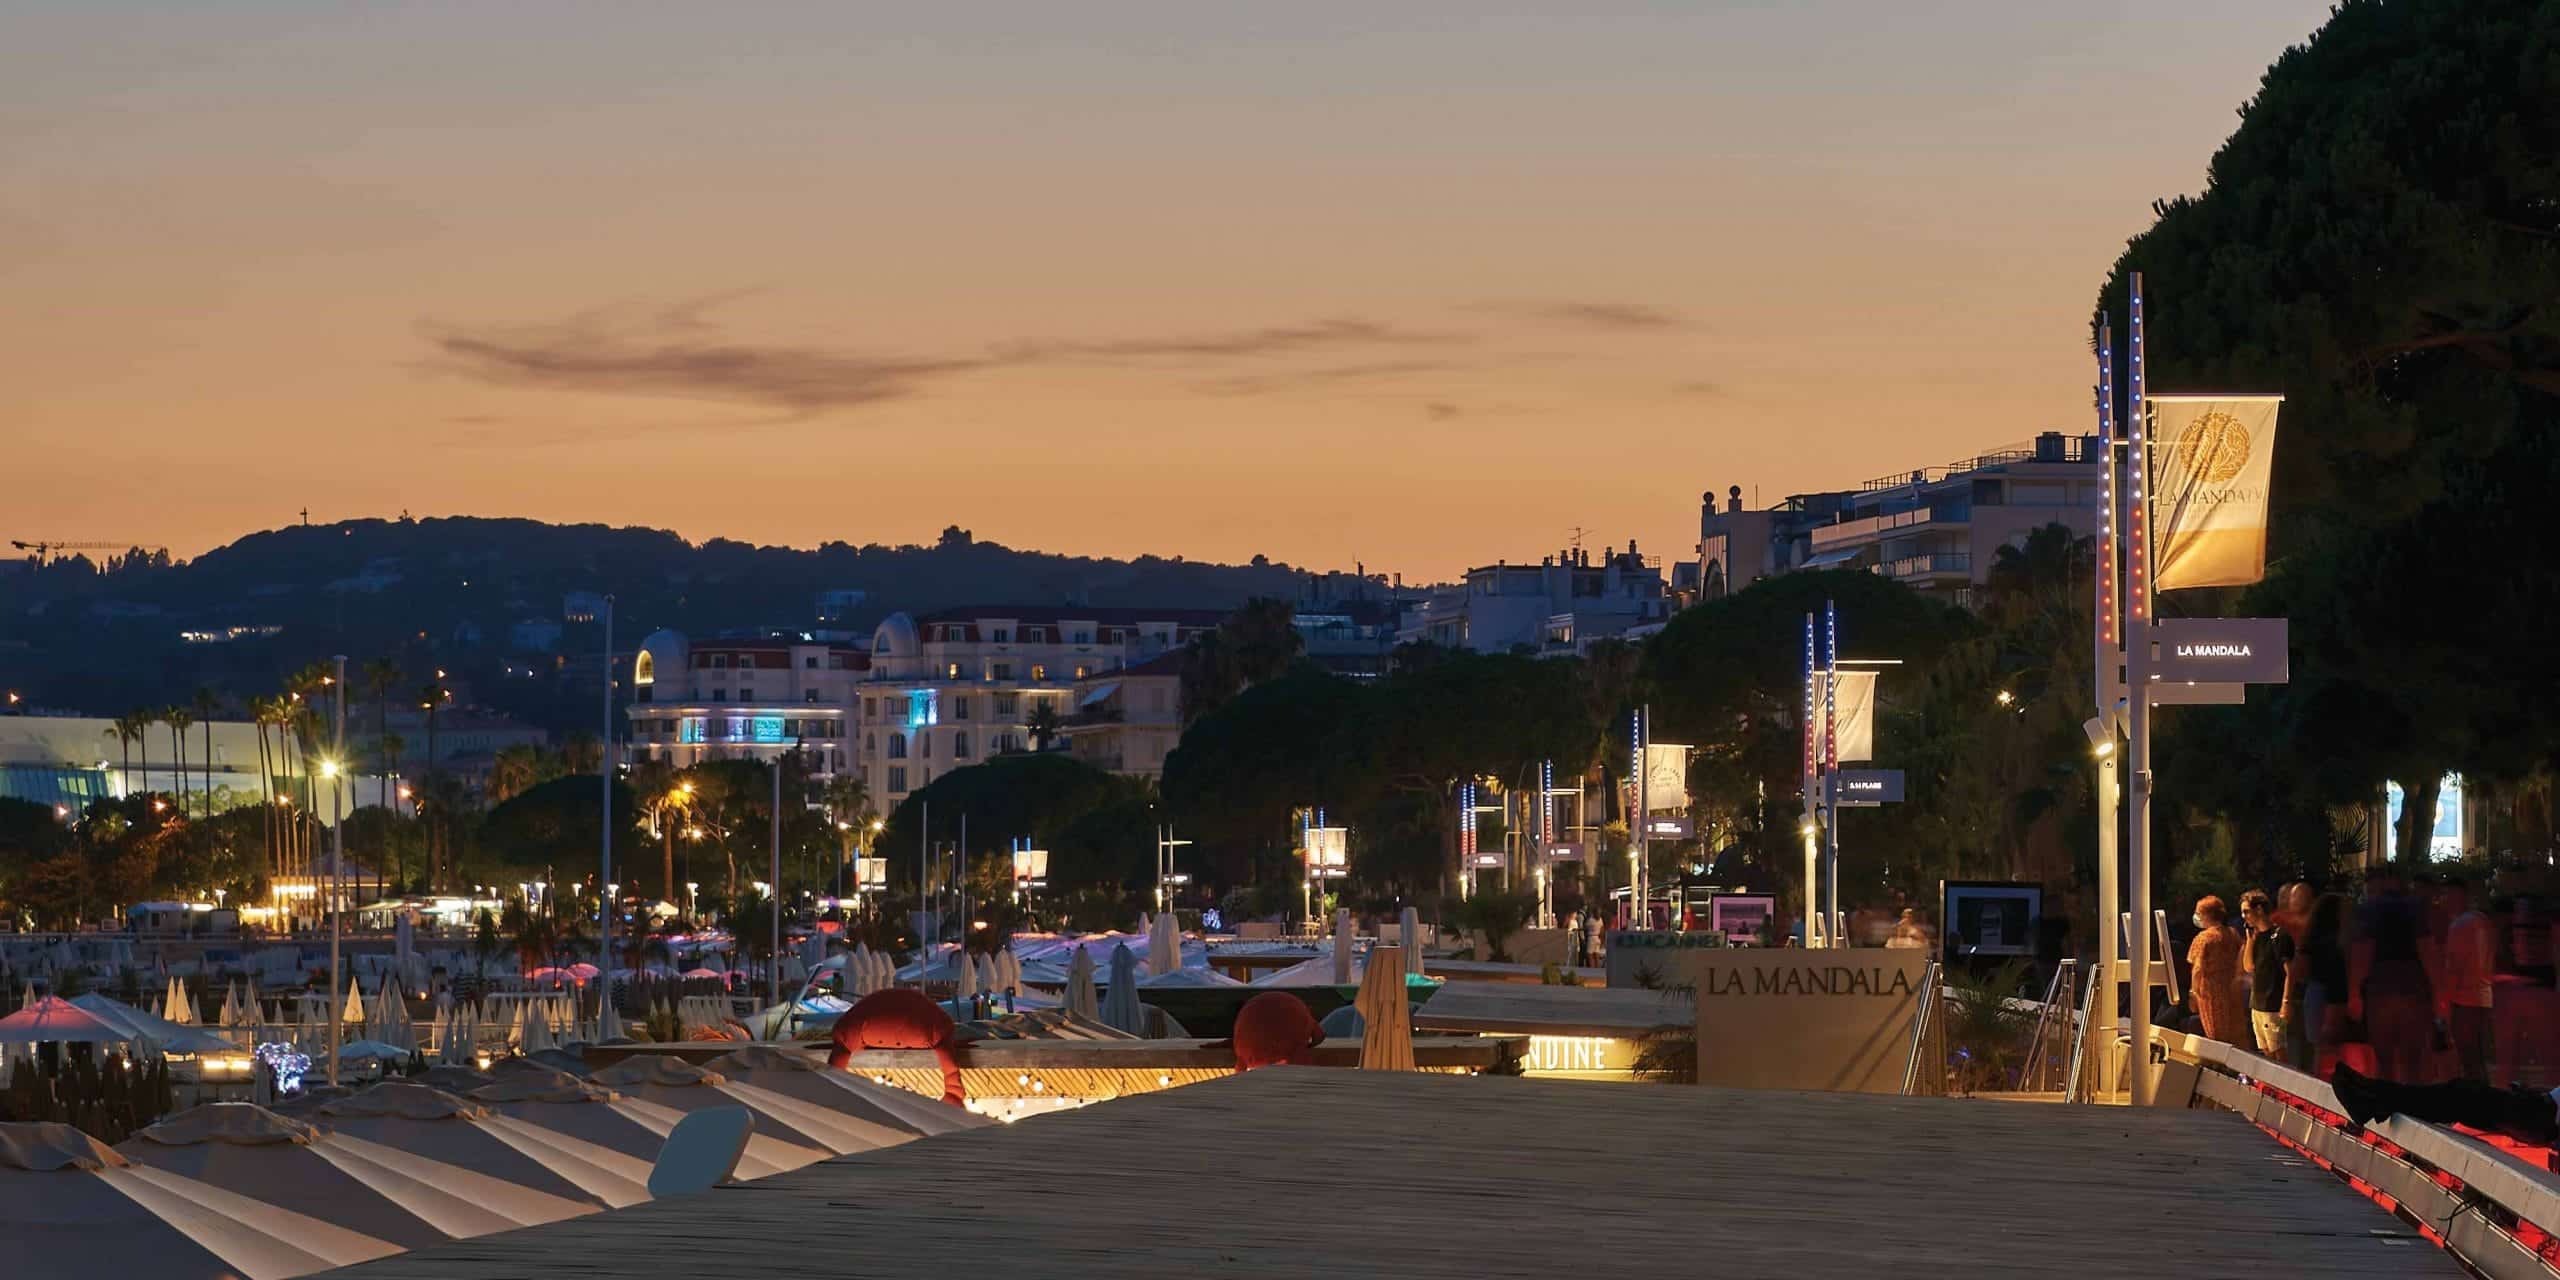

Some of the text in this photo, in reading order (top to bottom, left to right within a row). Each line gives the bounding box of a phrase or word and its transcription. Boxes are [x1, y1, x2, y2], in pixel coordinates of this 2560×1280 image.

[2177, 645, 2251, 656] LA MANDALA
[1708, 967, 1912, 996] LA MANDALA
